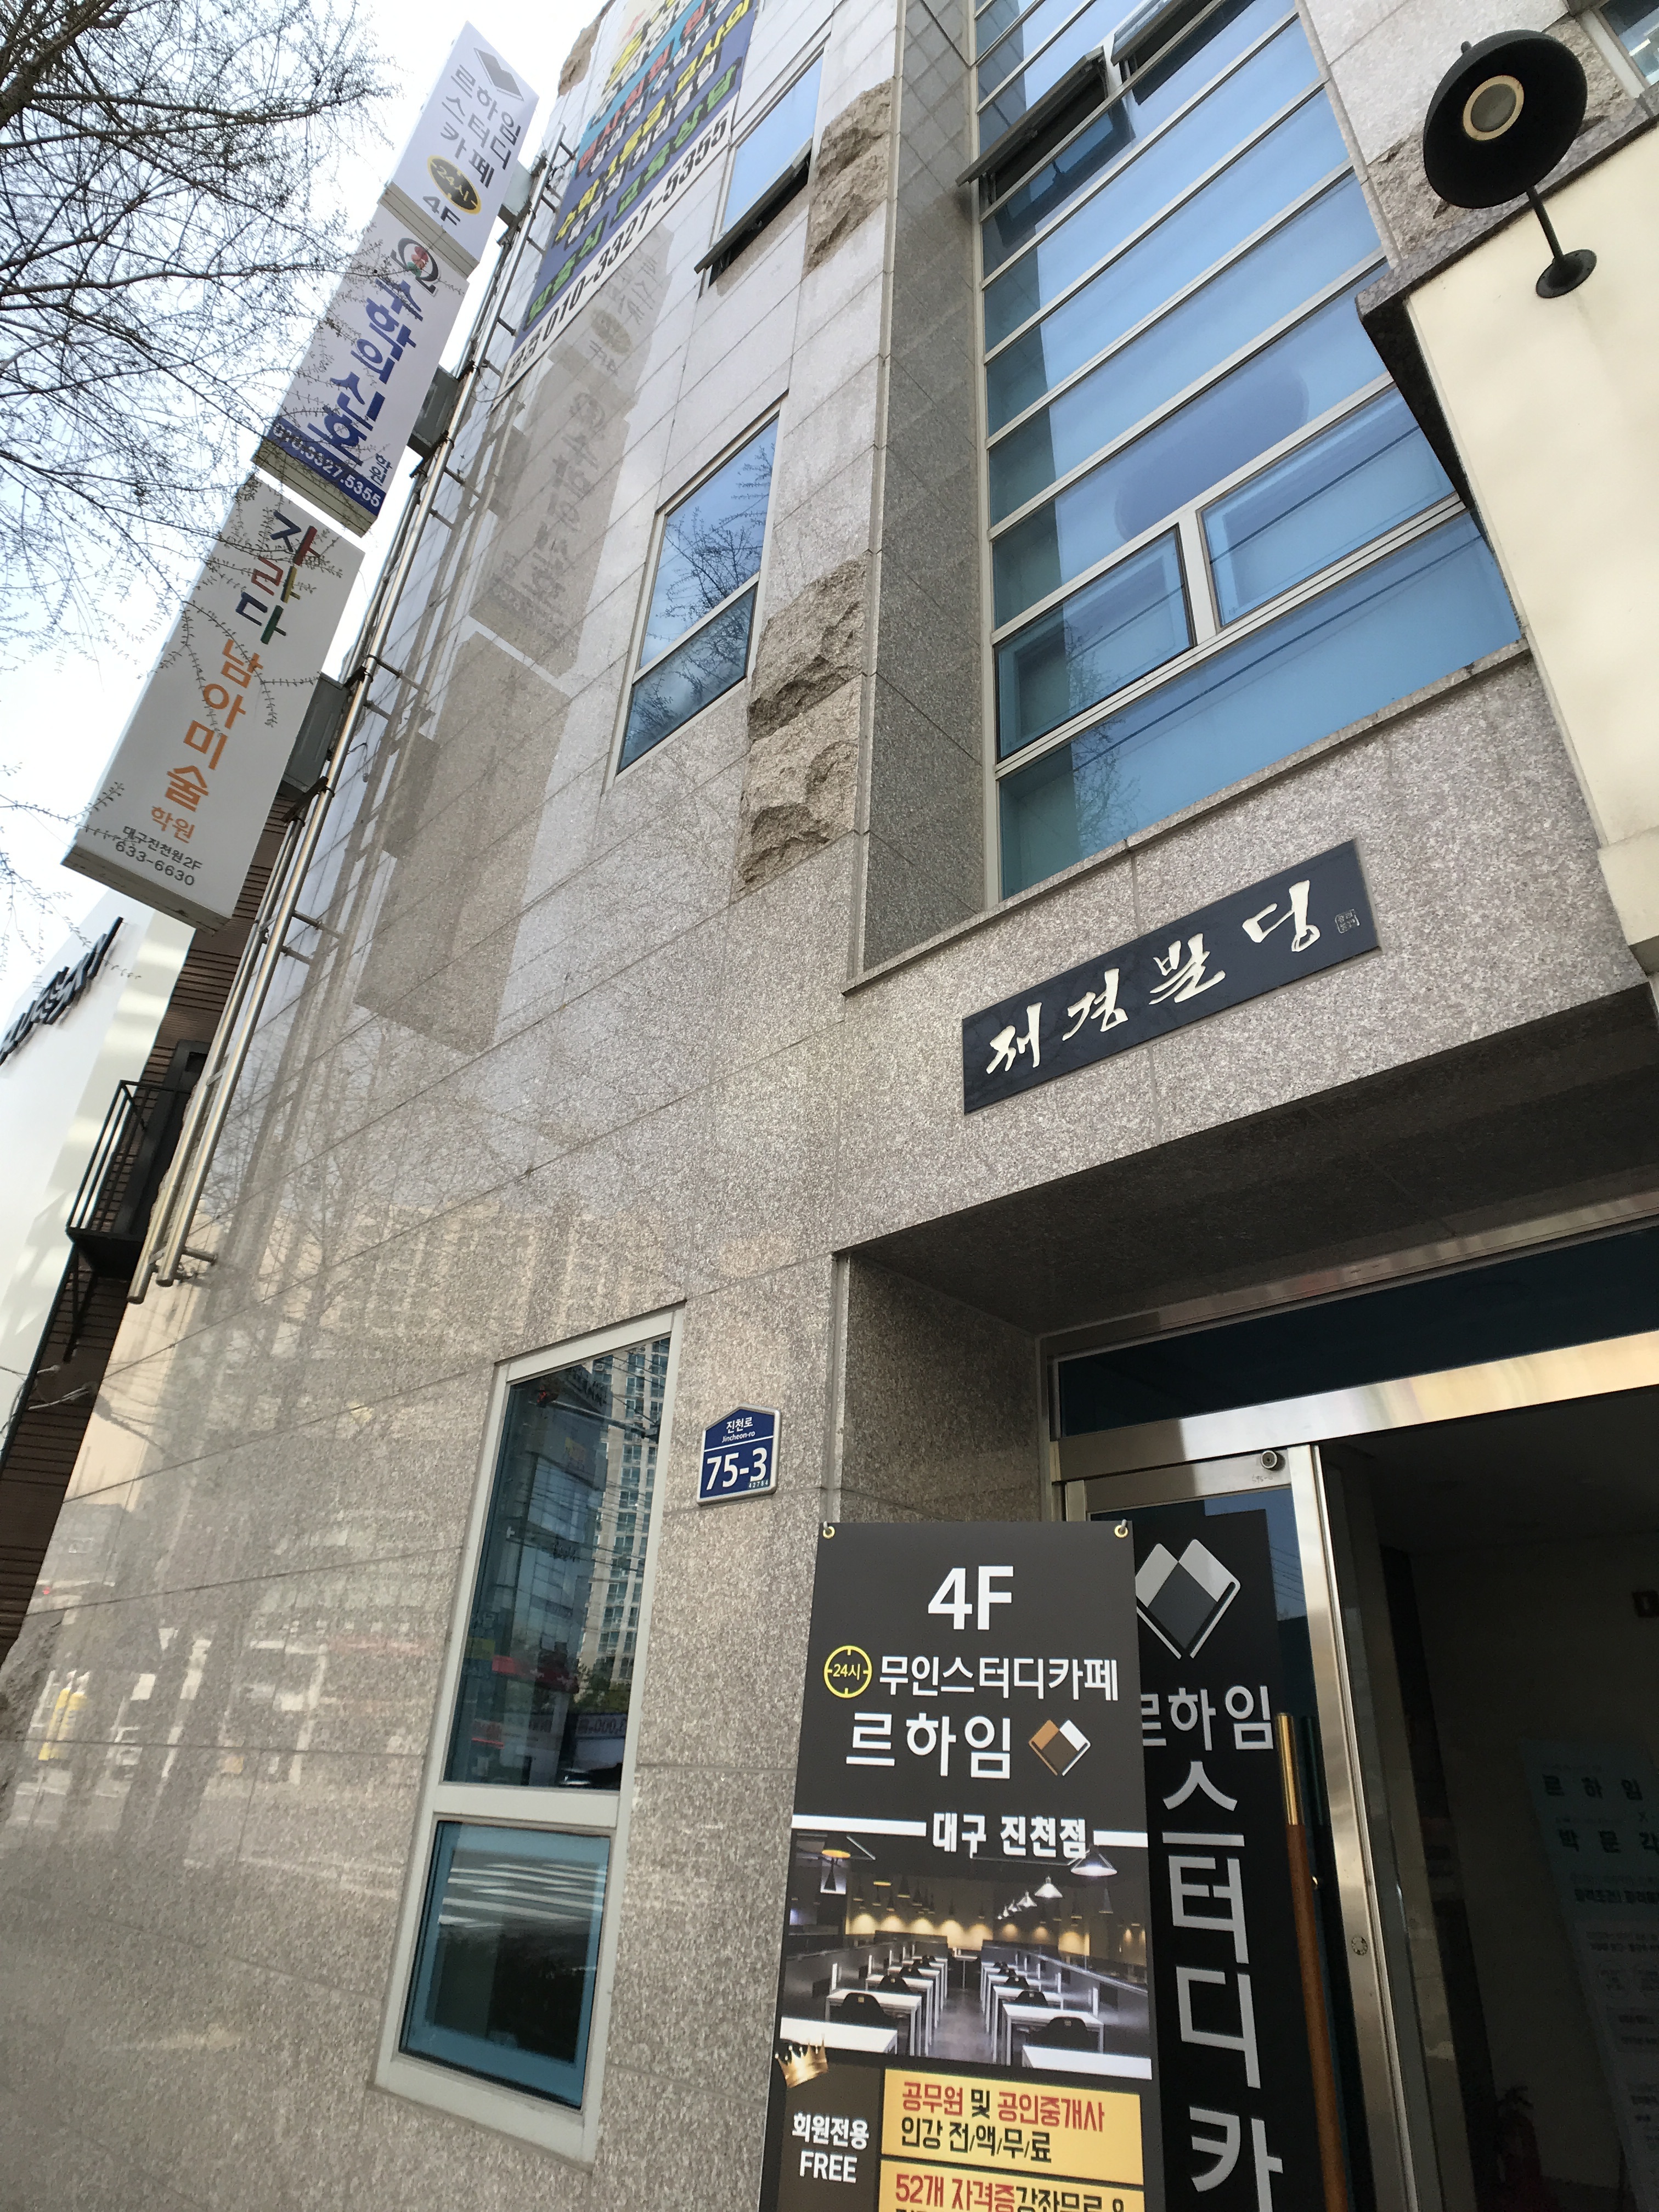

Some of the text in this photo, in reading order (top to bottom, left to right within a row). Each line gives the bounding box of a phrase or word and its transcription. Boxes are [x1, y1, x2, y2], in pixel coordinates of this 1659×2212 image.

[451, 64, 521, 146] 르하임
[441, 122, 495, 189] 카페
[442, 95, 512, 171] 스터디
[422, 195, 461, 227] 4F
[542, 111, 728, 342] 010-3327-5355
[369, 453, 393, 487] 학원
[166, 639, 264, 812] 남아미술
[151, 805, 196, 843] 학원
[115, 841, 195, 886] 633-6630
[721, 1430, 755, 1443] Jincheon-ro
[726, 1417, 753, 1434] 진천로
[706, 1447, 768, 1491] 75-3
[928, 1566, 1014, 1630] 4F
[832, 1656, 1118, 1701] 24시 무인스터디카페
[845, 1712, 1011, 1779] 르하임
[933, 1812, 1087, 1859] 대구 진천점
[902, 2081, 1105, 2133] 공무원 및 공인중개사
[792, 2112, 870, 2151] 회원전용
[901, 2117, 1052, 2164] 인강 전/액/무/료
[799, 2151, 858, 2184] FREE
[895, 2174, 944, 2208] 52개
